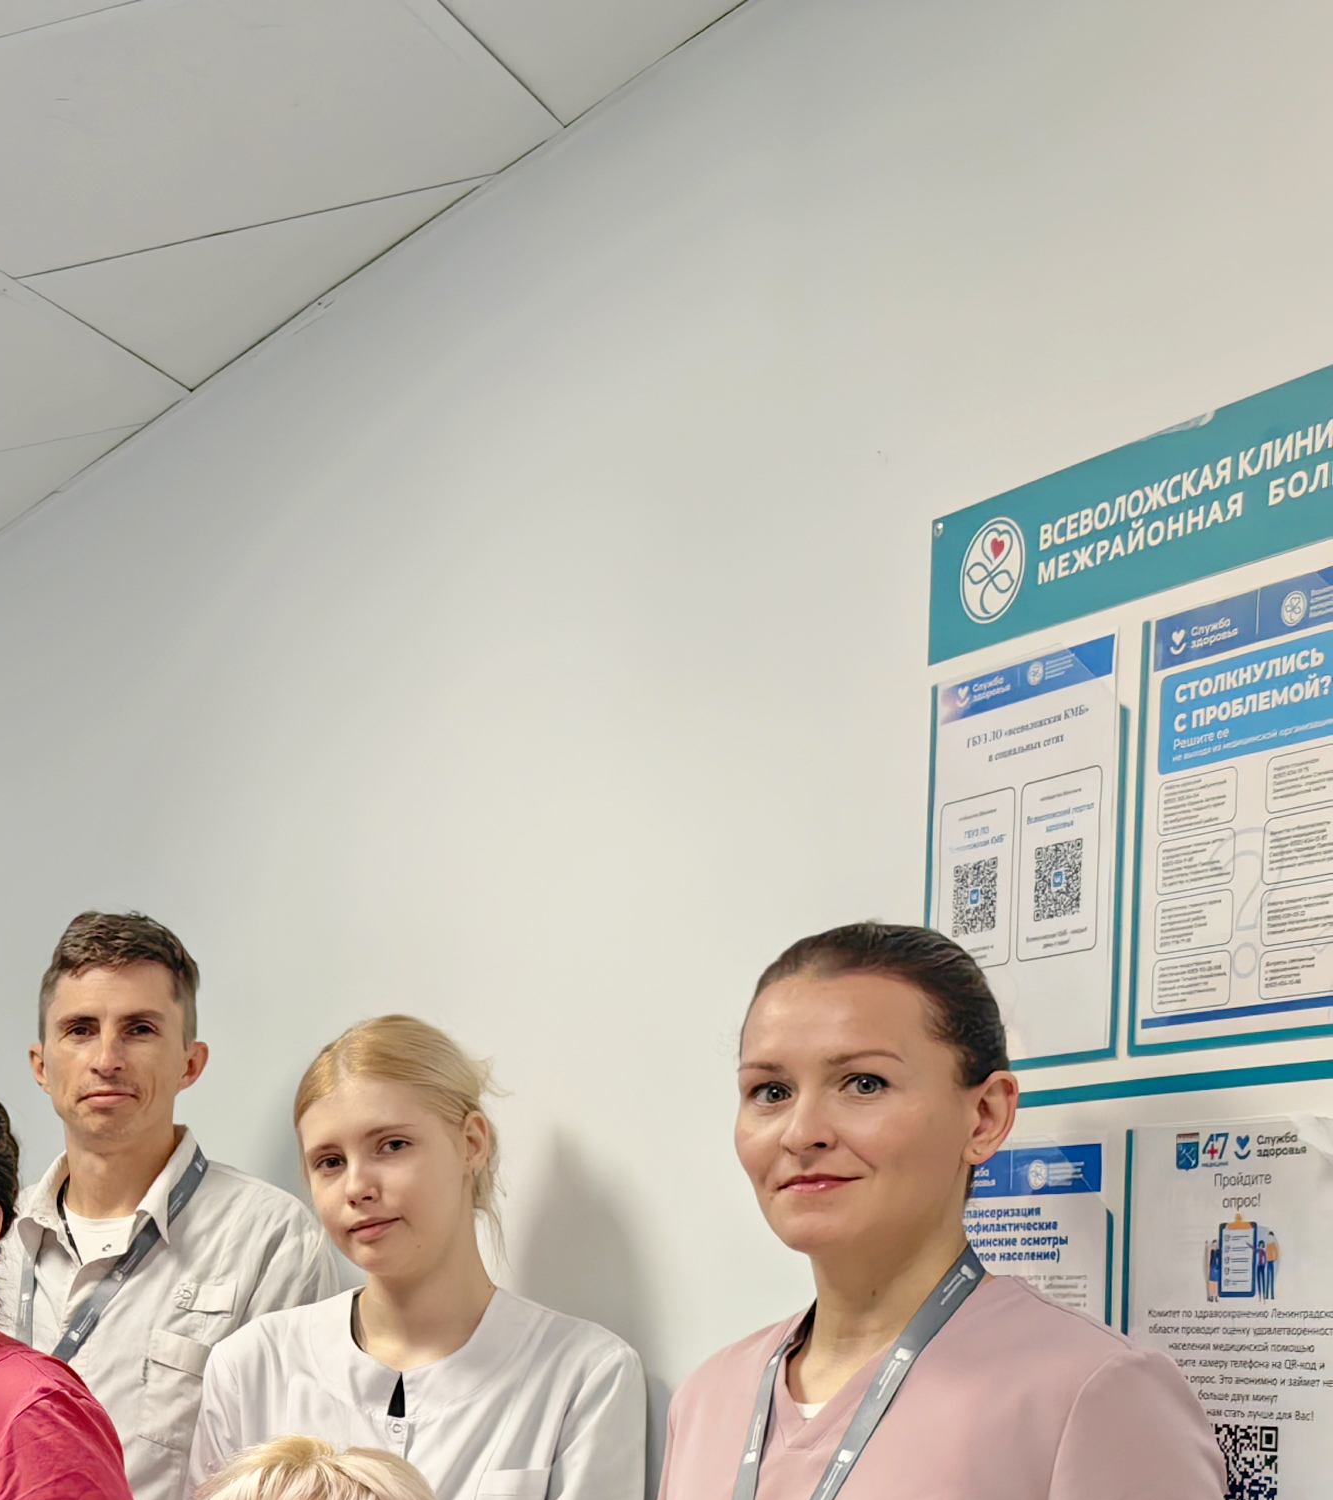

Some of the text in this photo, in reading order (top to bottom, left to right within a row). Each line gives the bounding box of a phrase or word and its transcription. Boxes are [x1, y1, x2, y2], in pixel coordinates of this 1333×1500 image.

[1039, 456, 1232, 551] ВСЕВОЛОЖСКАЯ
[1037, 462, 1333, 585] МЕЖРАЙОННАЯ БОЛ
[1191, 617, 1231, 637] Служба
[1174, 647, 1325, 703] СТОЛКНУЛИСЬ
[1174, 672, 1332, 732] С ПРОБЛЕМОЙ?
[1173, 732, 1215, 750] Решите
[1257, 1131, 1297, 1146] Служба
[1257, 1146, 1307, 1158] здоровья
[1214, 1172, 1272, 1189] Пройдите
[1222, 1193, 1261, 1211] опрос!
[1020, 1235, 1069, 1248] осмотры
[999, 1248, 1061, 1263] население)
[1148, 1309, 1180, 1318] Комитет
[1182, 1310, 1193, 1318] по
[1148, 1323, 1180, 1334] области
[1181, 1326, 1220, 1336] проводит
[1222, 1327, 1250, 1337] оценку
[1168, 1342, 1315, 1354] населения медицинской помощью
[1199, 1360, 1228, 1370] камеру
[1230, 1358, 1269, 1371] телефона
[1272, 1361, 1282, 1369] на
[1319, 1362, 1325, 1370] и
[1219, 1374, 1233, 1384] Это
[1234, 1377, 1278, 1387] анонимно
[1198, 1389, 1229, 1401] больше
[1230, 1393, 1250, 1403] двух
[1224, 1409, 1245, 1418] стать
[1247, 1411, 1274, 1421] лучше
[1276, 1411, 1292, 1421] для
[1295, 1410, 1315, 1421] Вас!
